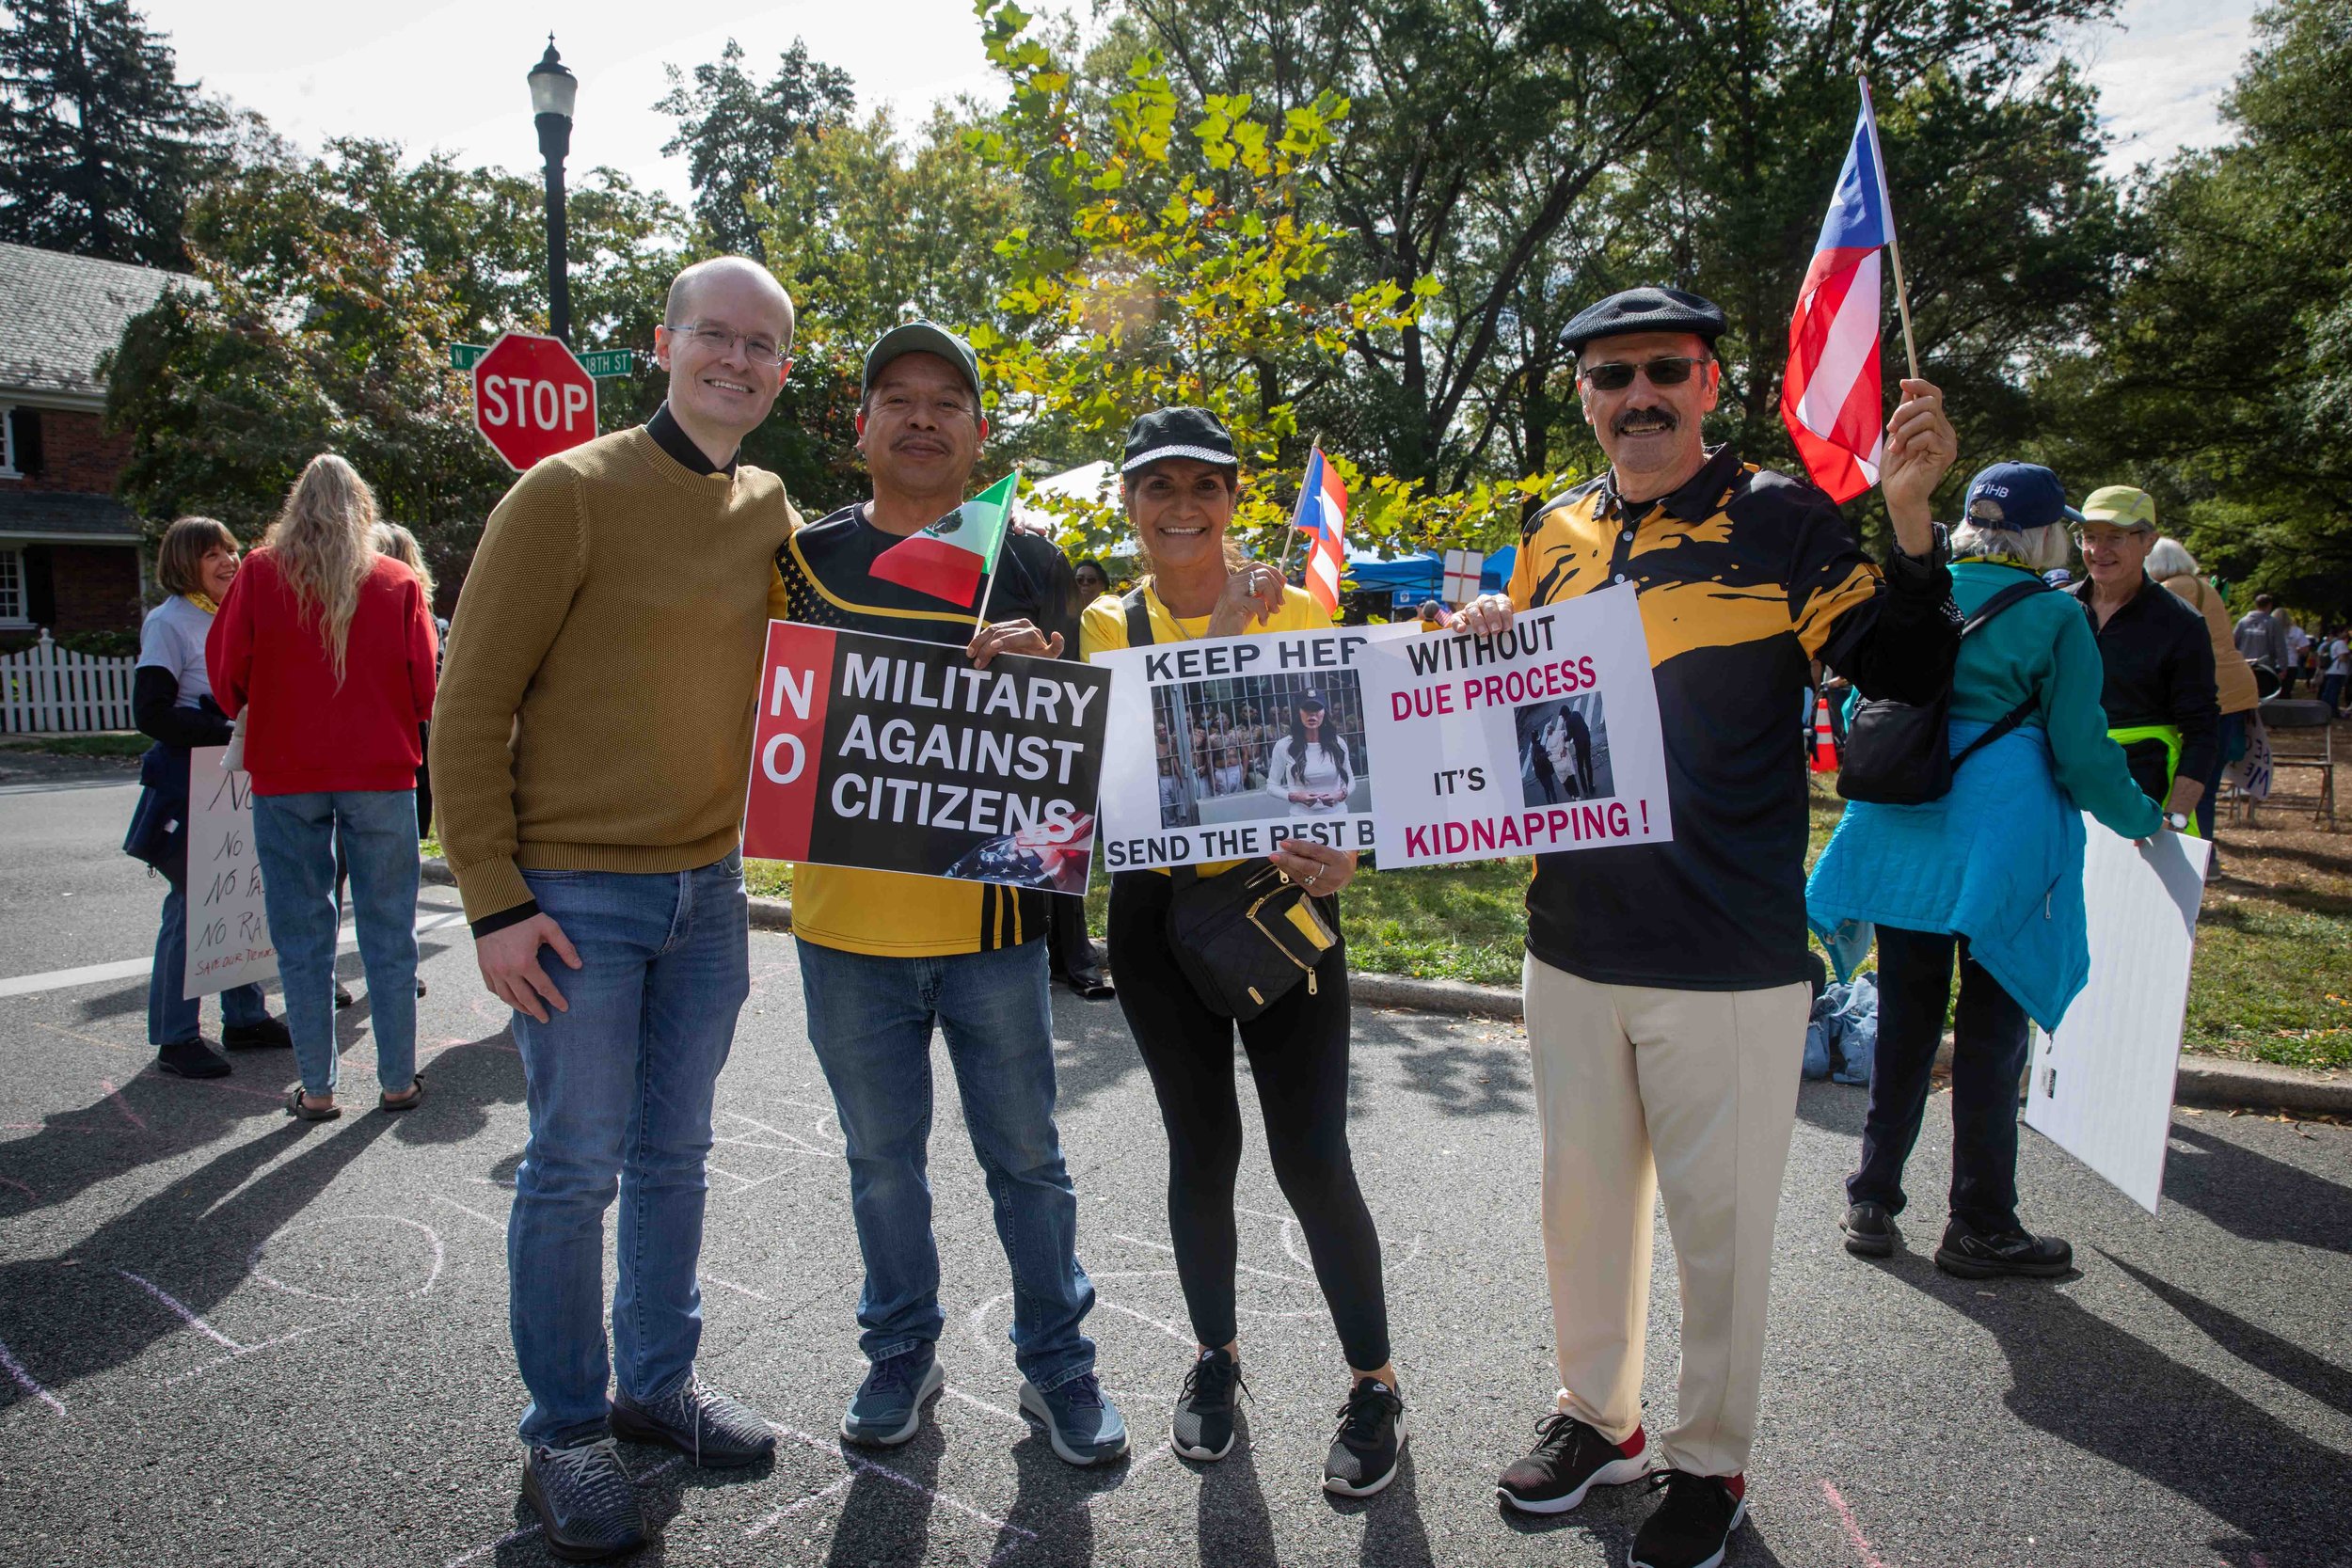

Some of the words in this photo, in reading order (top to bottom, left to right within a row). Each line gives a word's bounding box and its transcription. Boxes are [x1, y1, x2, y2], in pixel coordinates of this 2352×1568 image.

[586, 356, 610, 373] 18TH
[614, 354, 628, 371] ST
[484, 374, 588, 432] STOP
[1145, 643, 1261, 682] KEEP
[1406, 615, 1556, 676] WITHOUT
[842, 653, 1099, 727] MILITARY
[1391, 683, 1454, 722] DUE
[1464, 656, 1597, 710] PROCESS
[838, 715, 1084, 784] AGAINST
[1434, 767, 1486, 796] IT'S
[831, 772, 1076, 844] CITIZENS
[1405, 801, 1630, 858] KIDNAPPING
[214, 831, 243, 861] NO
[1107, 835, 1190, 867] SEND
[1200, 827, 1260, 855] THE
[204, 868, 237, 907] NO
[246, 863, 265, 897] FA
[195, 917, 227, 952] NO
